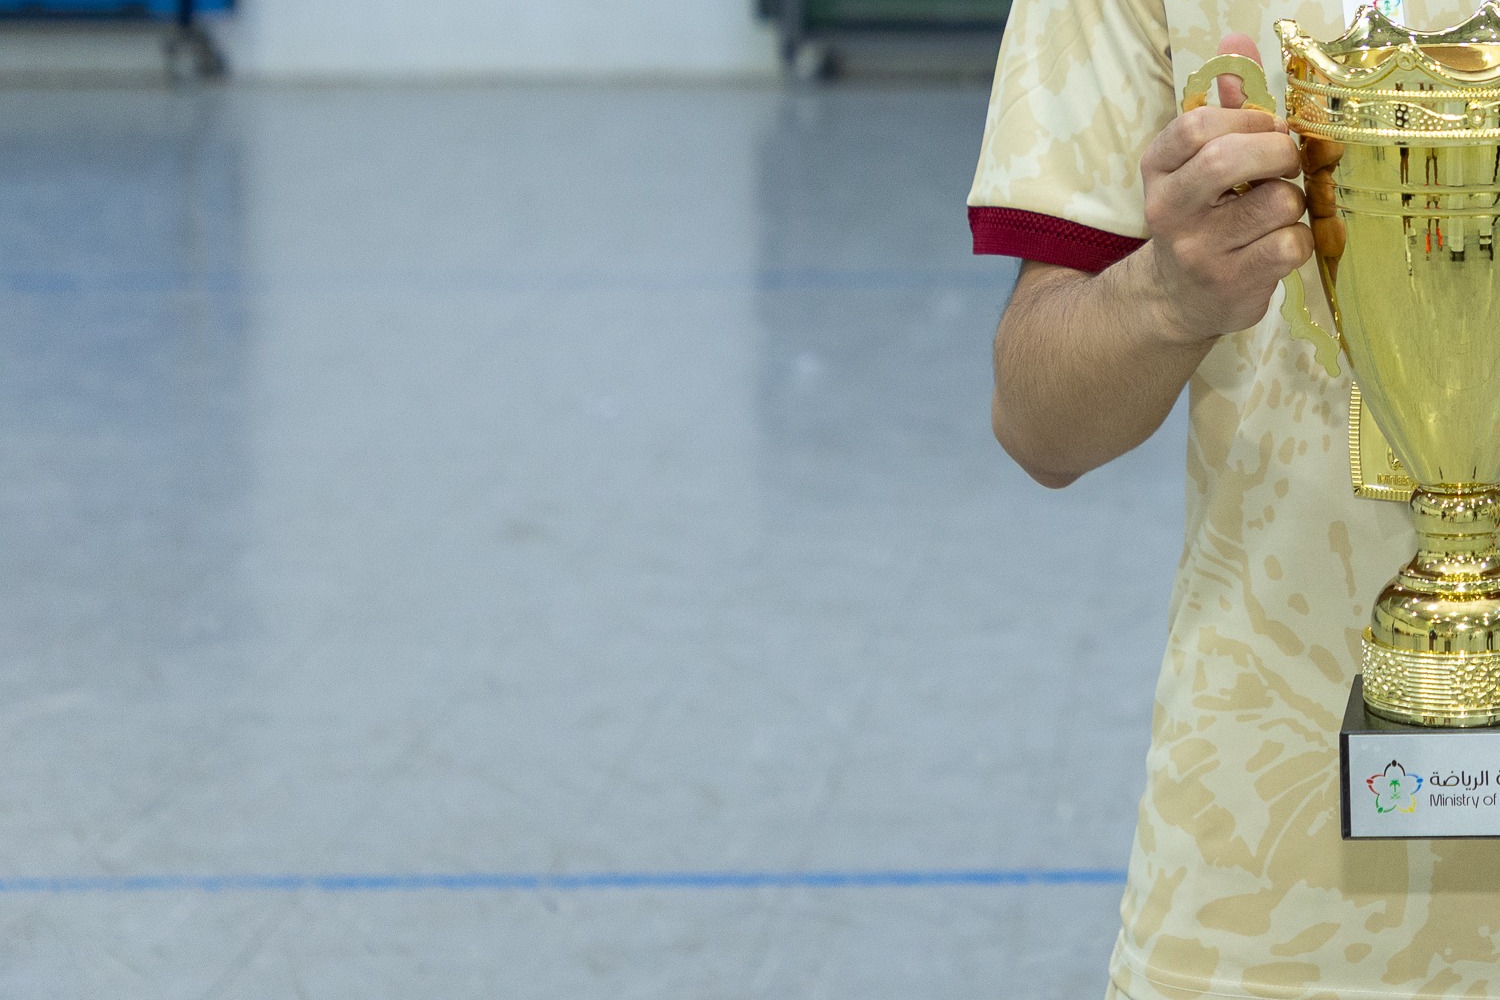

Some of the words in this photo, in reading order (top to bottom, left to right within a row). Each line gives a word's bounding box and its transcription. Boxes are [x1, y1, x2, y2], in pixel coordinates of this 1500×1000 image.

[1429, 770, 1489, 791] الرياضة
[1429, 793, 1480, 808] Ministry
[1483, 793, 1497, 806] of
